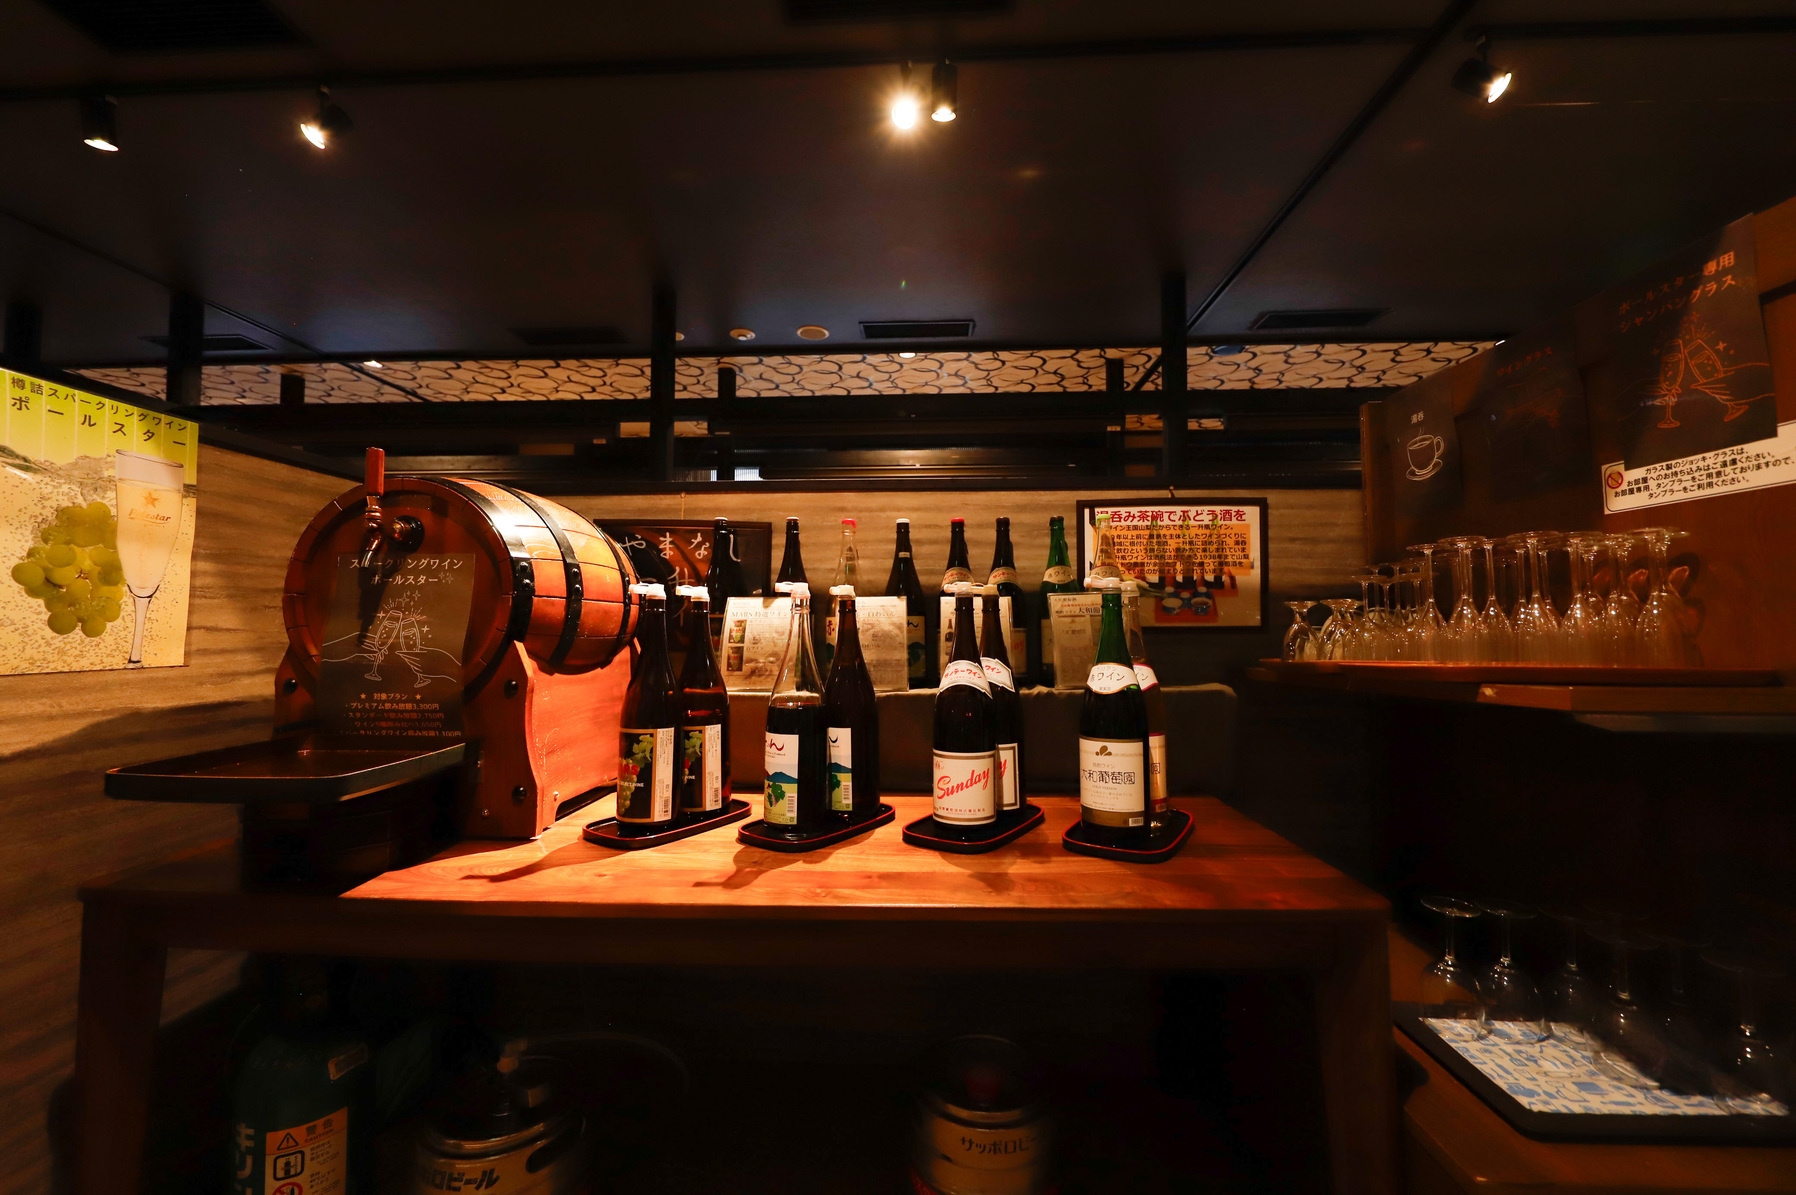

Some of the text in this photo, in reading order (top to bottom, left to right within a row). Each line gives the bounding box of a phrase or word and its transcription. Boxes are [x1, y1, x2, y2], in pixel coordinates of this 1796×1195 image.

[11, 376, 187, 431] 樽詰スパークリングワイン
[11, 396, 186, 446] ポールスター
[620, 531, 742, 563] やまなし
[350, 557, 463, 570] スークリングワイン
[937, 767, 990, 800] Sunday
[960, 1136, 1042, 1155] サッポロビー
